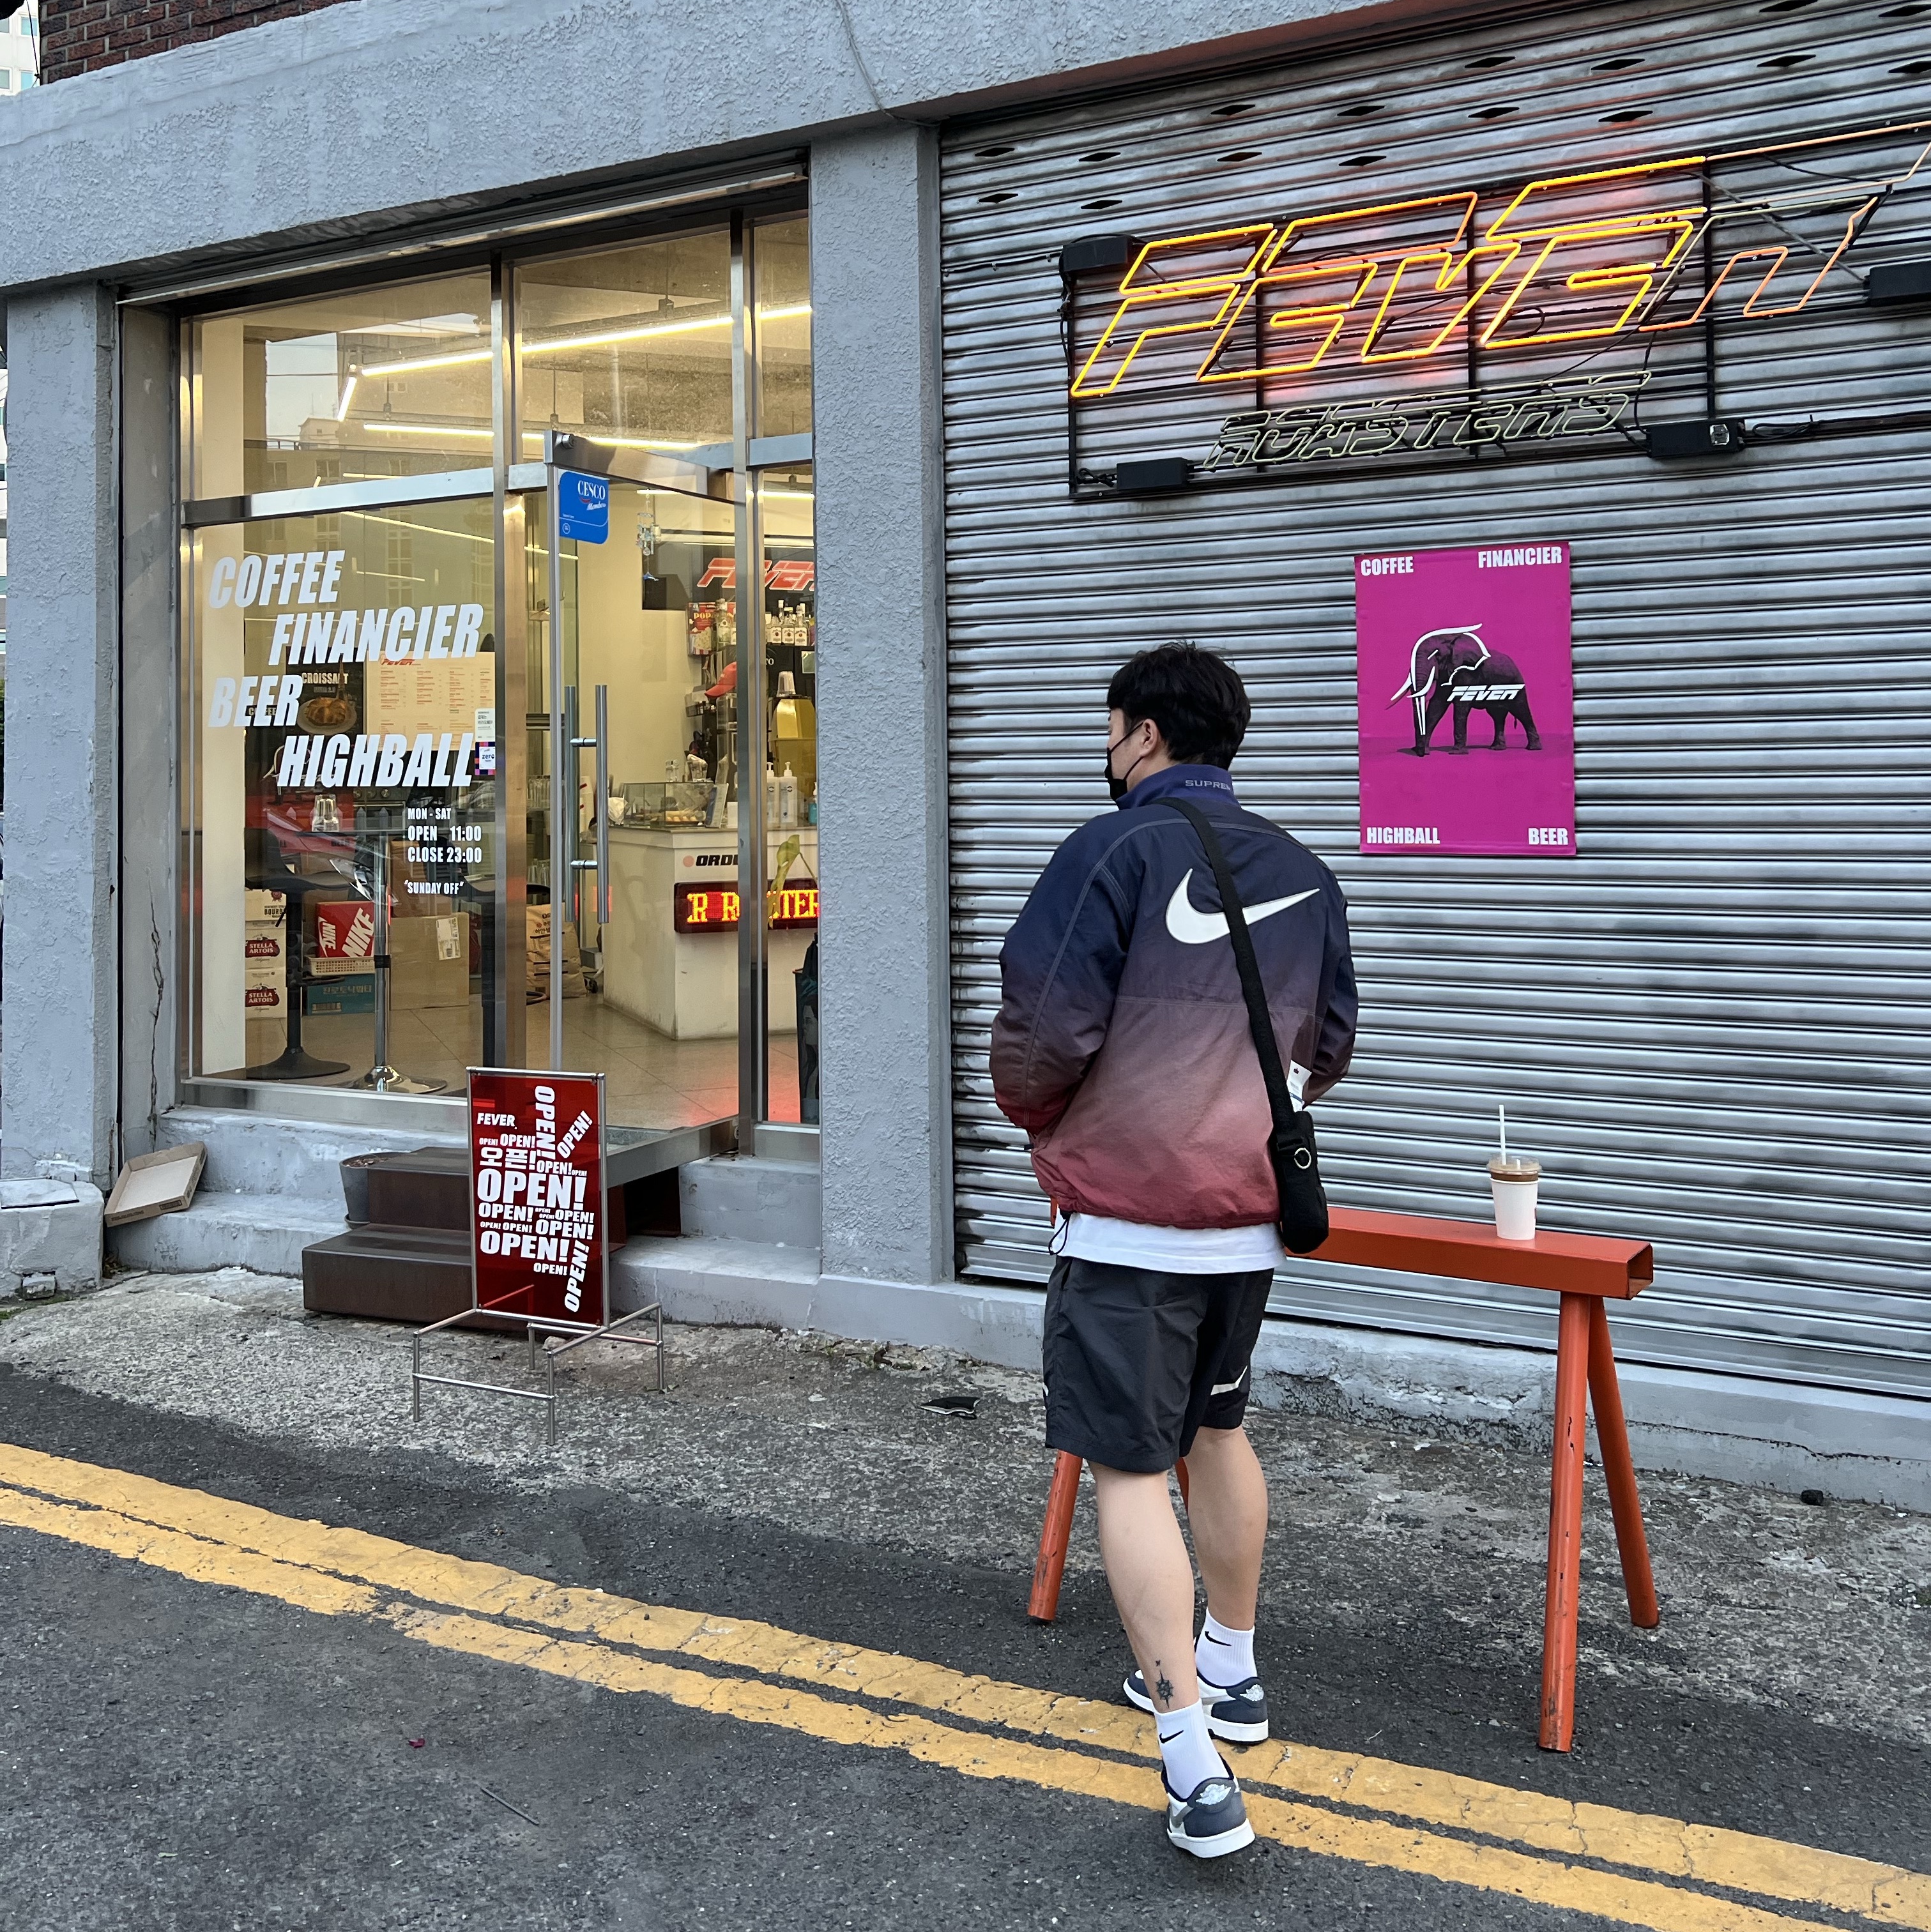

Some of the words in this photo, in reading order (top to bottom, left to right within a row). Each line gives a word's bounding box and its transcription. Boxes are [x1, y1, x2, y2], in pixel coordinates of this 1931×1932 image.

[1071, 123, 1931, 397] FEVER
[577, 480, 606, 500] CESCO
[1360, 556, 1414, 576] COFFEE
[1477, 546, 1562, 568] FINANCIER
[208, 549, 346, 609] COFFEE
[268, 603, 484, 666] FINANCIER
[208, 674, 303, 728] BEER
[1446, 683, 1525, 703] FEVER
[277, 733, 474, 788] HIGHBALL
[408, 808, 427, 820] MON
[435, 807, 452, 820] SAT
[408, 825, 438, 841] OPEN
[450, 825, 482, 842] 11:00
[1366, 826, 1440, 845] HIGHBALL
[1528, 826, 1569, 845] BEER
[408, 846, 444, 863] CLOSE
[446, 846, 482, 863] 23:00
[696, 854, 738, 867] ORD
[322, 922, 336, 950] NIKE
[342, 907, 374, 957] NIKE
[535, 1085, 556, 1160] OPEN!
[478, 1137, 498, 1146] OPEN!
[500, 1133, 536, 1148] OPEN!
[557, 1110, 593, 1159] OPEN!
[537, 1160, 572, 1175] OPEN!
[477, 1168, 587, 1211] OPEN!
[478, 1202, 534, 1222] OPEN!
[554, 1209, 595, 1224] OPEN!
[480, 1221, 501, 1229] OPEN!
[502, 1222, 533, 1233] OPEN!
[535, 1219, 595, 1240] OPEN!
[480, 1230, 570, 1263] OPEN!
[533, 1262, 568, 1276] OPEN!
[564, 1239, 590, 1312] OPEN!
